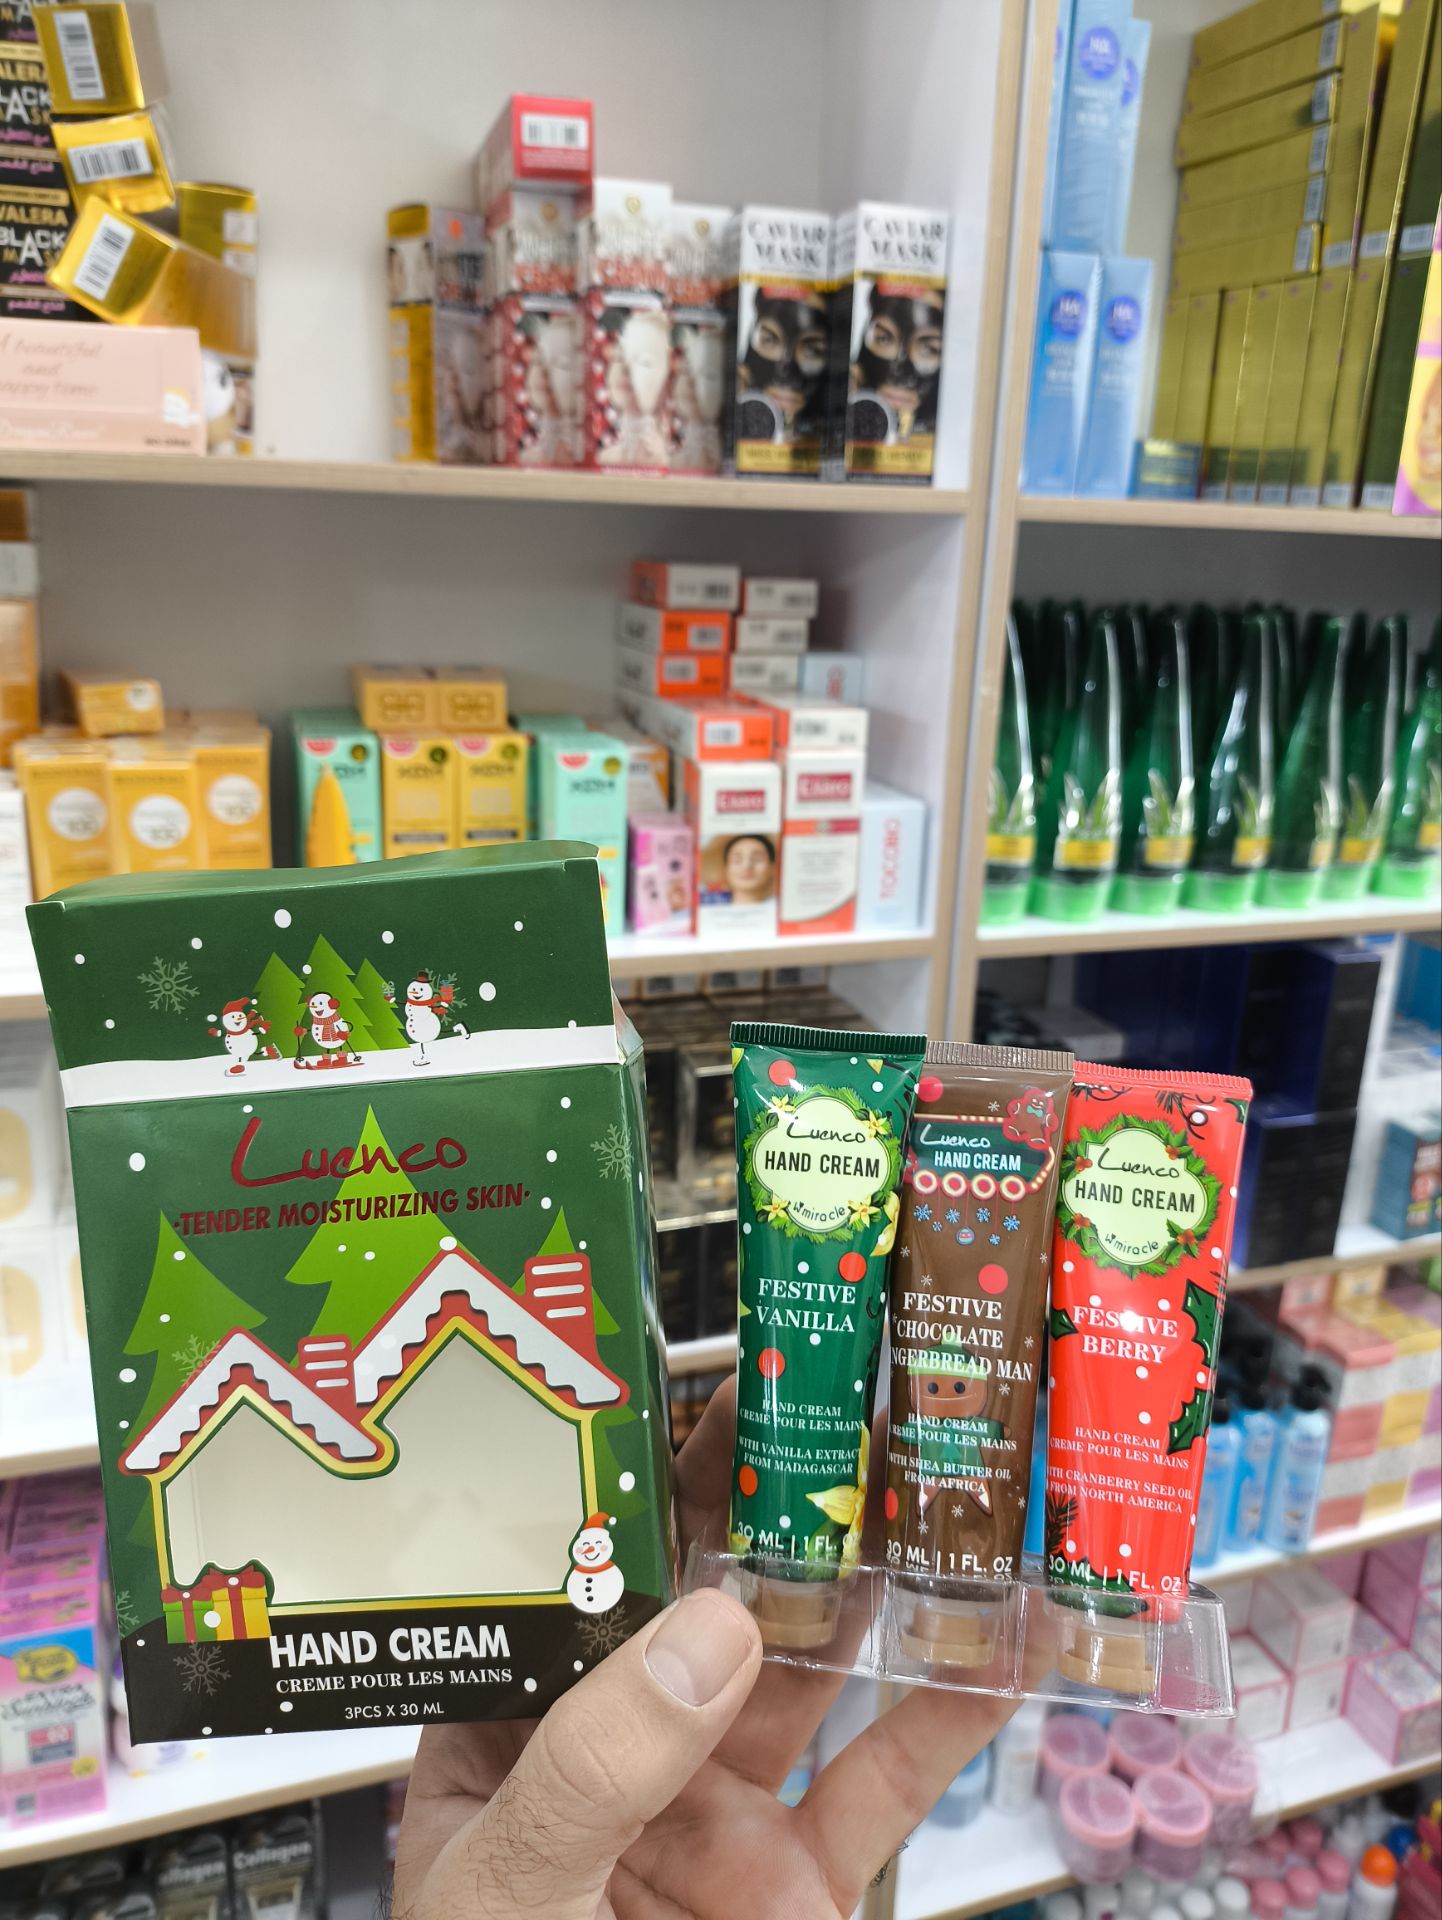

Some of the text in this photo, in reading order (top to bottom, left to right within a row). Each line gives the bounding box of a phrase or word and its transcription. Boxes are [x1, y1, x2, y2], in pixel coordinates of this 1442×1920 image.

[786, 1117, 866, 1143] Luenco
[919, 1124, 991, 1148] Luenco
[231, 1116, 467, 1188] Luenco
[764, 1150, 880, 1178] HAND CREAM
[934, 1150, 1022, 1171] HAND CREAM
[1097, 1147, 1180, 1178] Luenco
[278, 1191, 459, 1227] MOISTURIZING
[1074, 1180, 1195, 1213] HAND CREAM
[757, 1277, 856, 1304] FESTIVE
[757, 1305, 855, 1333] VANILLA
[903, 1291, 1003, 1320] FESTIVE
[896, 1319, 1004, 1348] CHOCOLATE
[1072, 1305, 1178, 1338] FESIVE
[1082, 1334, 1166, 1364] BERRY
[996, 1358, 1032, 1381] MAN
[739, 1408, 771, 1424] CREME
[809, 1420, 831, 1431] LES
[799, 1404, 841, 1417] CREAM
[943, 1417, 988, 1433] CREAM
[1075, 1427, 1160, 1449] HAND CREAM
[762, 1443, 812, 1459] VANILLA
[919, 1430, 951, 1443] POUR
[954, 1434, 978, 1447] LES
[980, 1437, 1017, 1451] MAINS
[1049, 1436, 1189, 1469] CREME POUR LES MAINS
[744, 1452, 853, 1475] FROM MADAGASCAR
[909, 1456, 940, 1472] SHEA
[943, 1462, 993, 1478] BUTTER
[995, 1468, 1012, 1480] OIL
[904, 1470, 987, 1492] FROM AFRICA
[1047, 1466, 1193, 1500] ITH CRANBERRY SEED OIL
[1050, 1481, 1183, 1513] FROM NORTH AMERICA
[738, 1521, 754, 1539] 30
[759, 1529, 784, 1549] ML
[803, 1535, 809, 1551] 1
[815, 1535, 837, 1552] FL.
[887, 1539, 1013, 1573] 30 ML 1 FL. OZ
[1048, 1555, 1182, 1592] 30 ML 1 FL. OZ
[269, 1624, 511, 1668] HAND CREAM
[276, 1668, 513, 1694] CREME POUR LES MAINS
[344, 1702, 444, 1719] 3PCS X 30 ML
